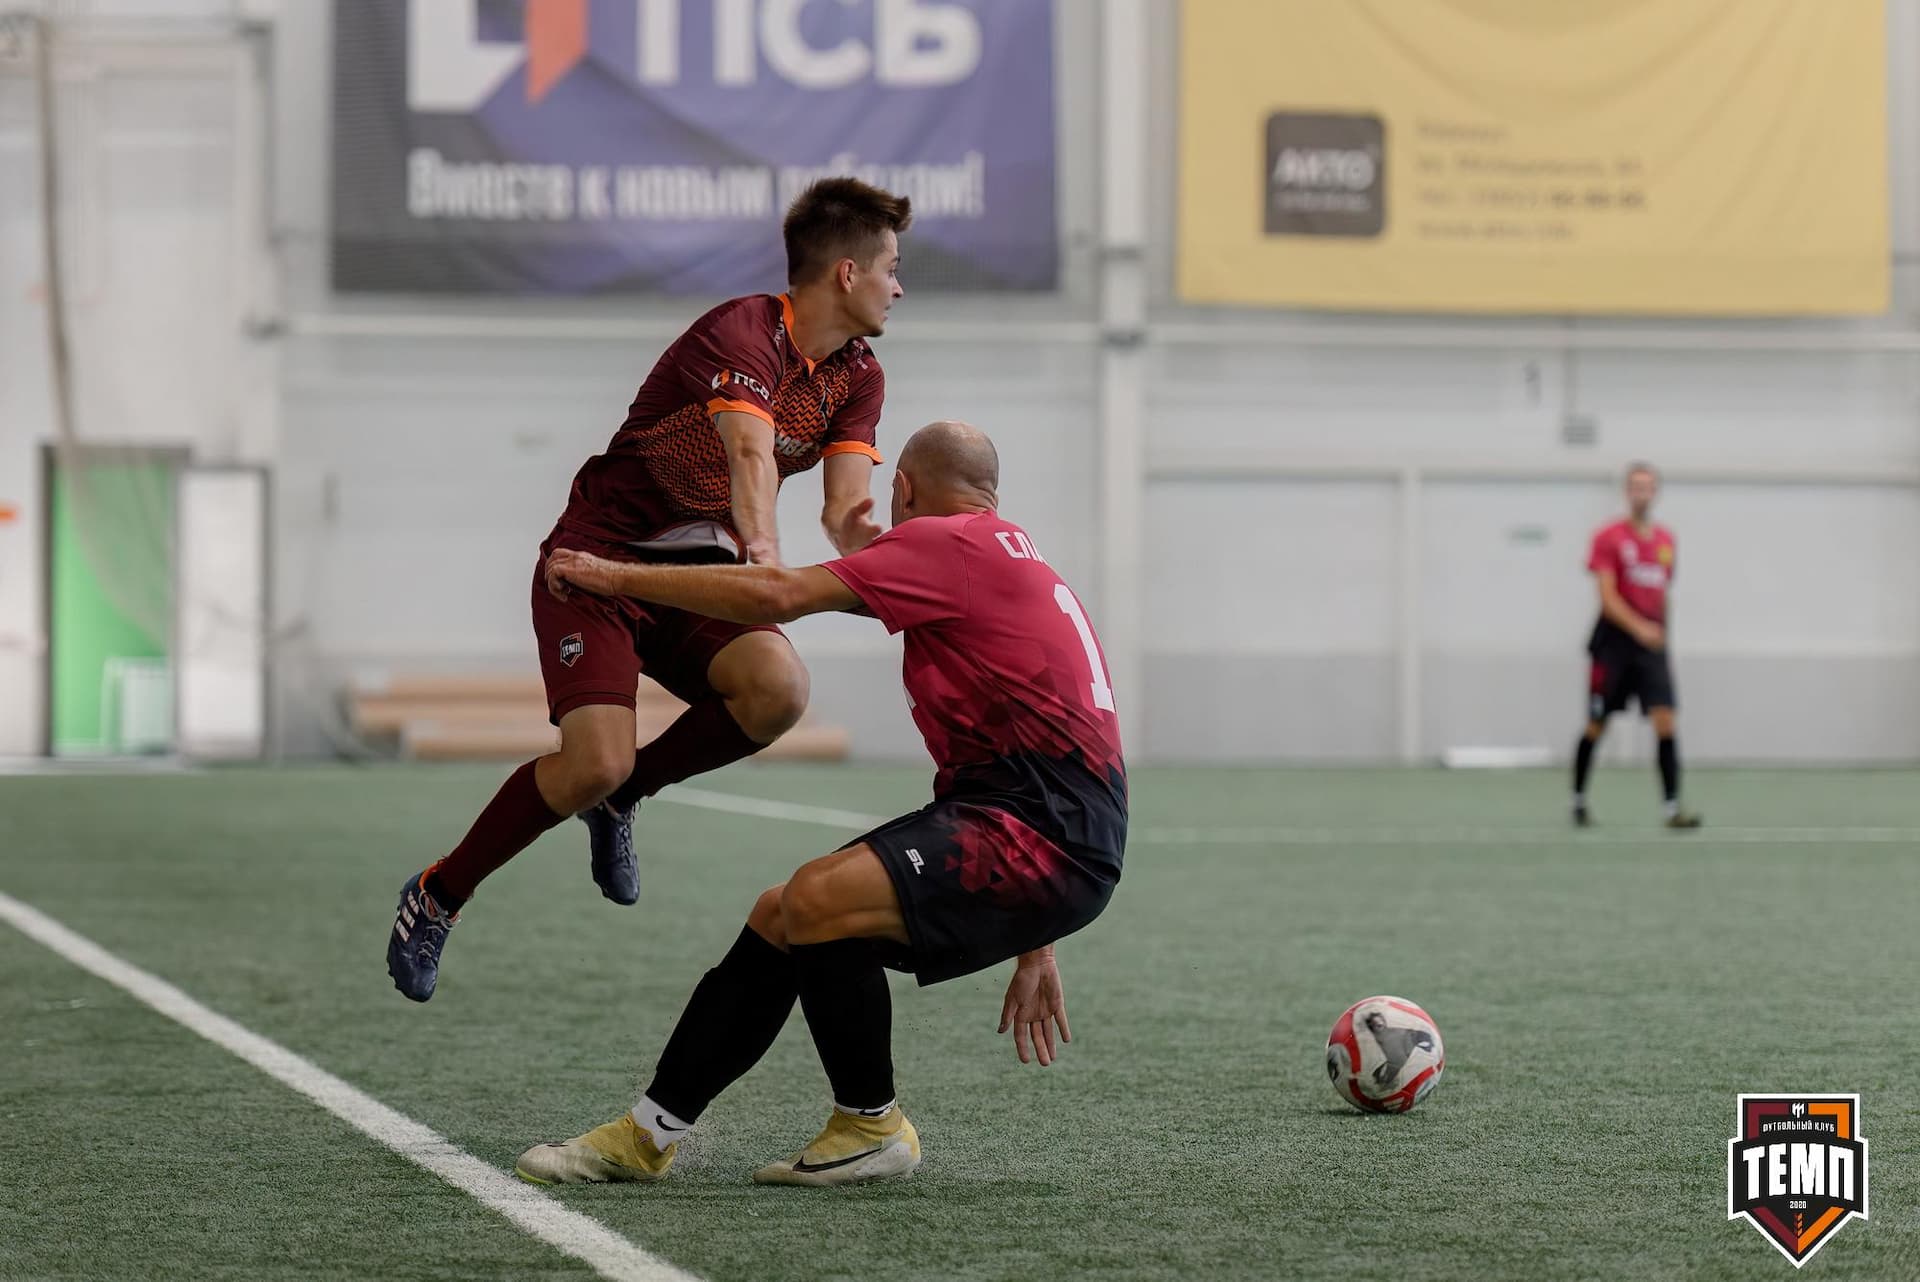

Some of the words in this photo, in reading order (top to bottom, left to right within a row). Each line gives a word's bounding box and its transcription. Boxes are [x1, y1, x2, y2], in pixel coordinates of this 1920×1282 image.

[577, 165, 609, 219] к
[615, 166, 771, 220] новым
[1053, 583, 1116, 715] 1
